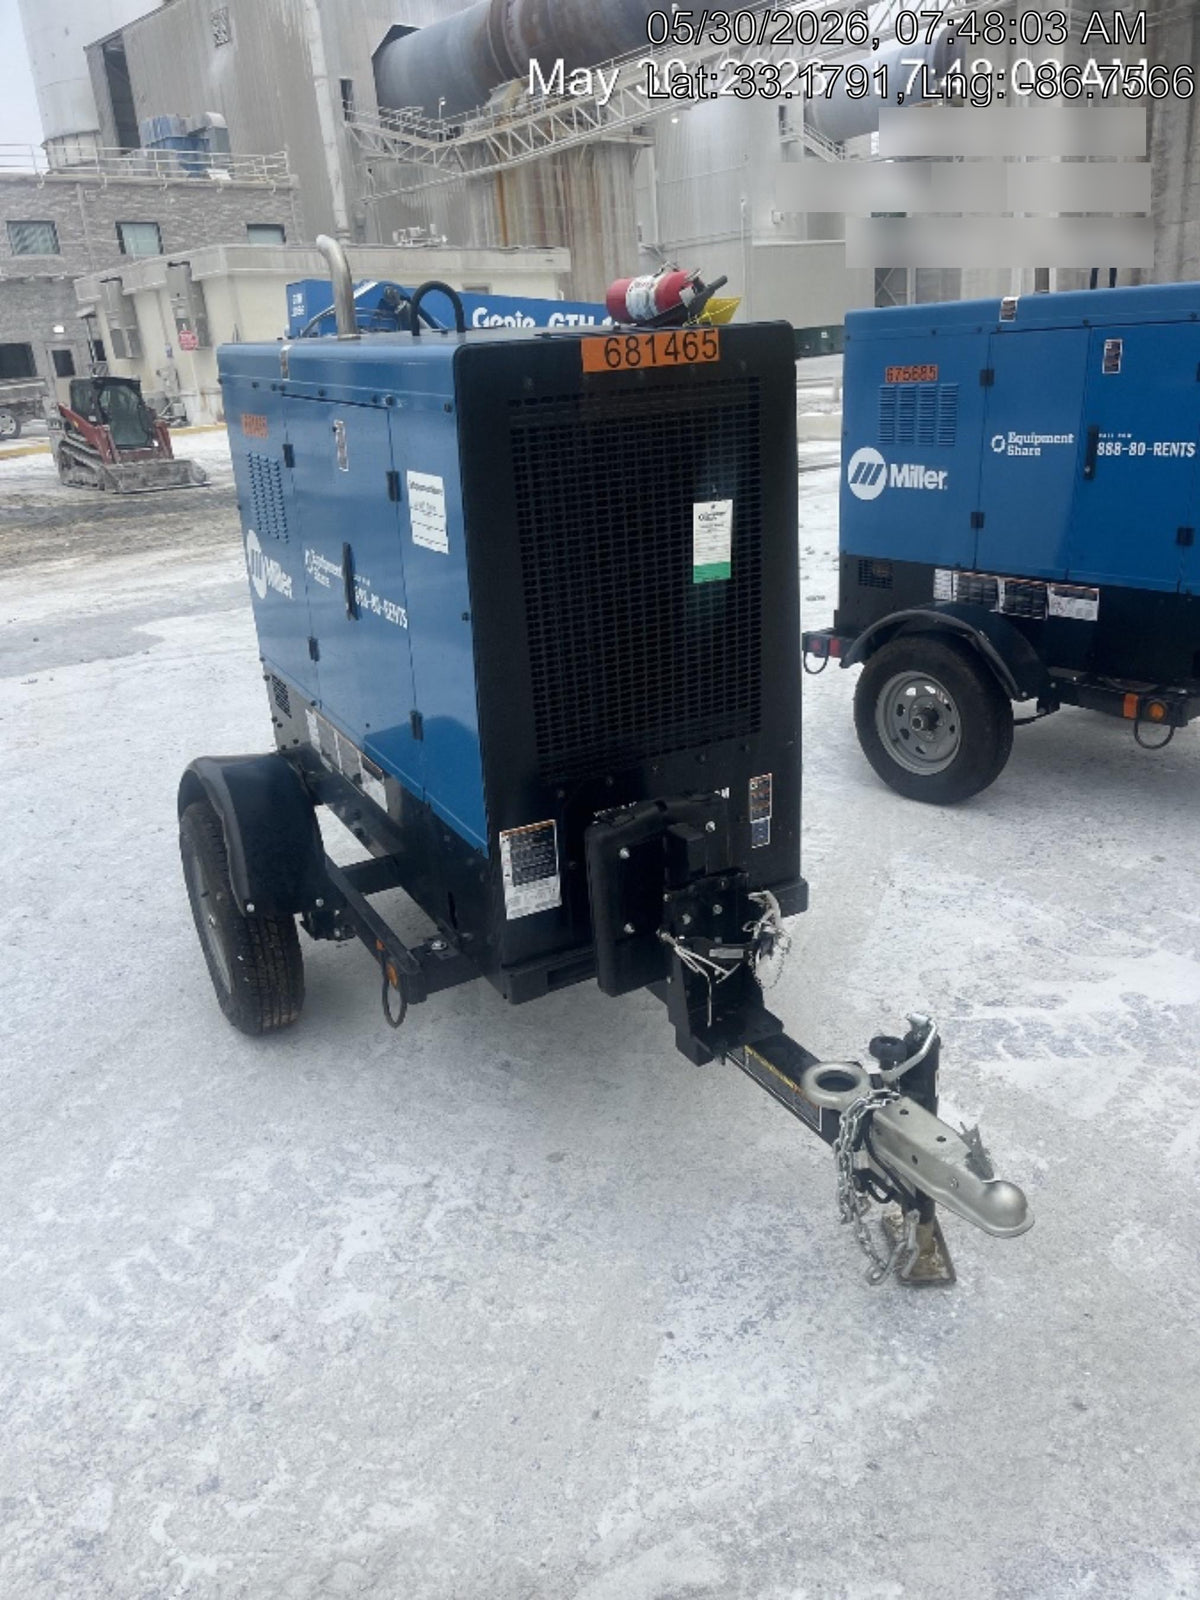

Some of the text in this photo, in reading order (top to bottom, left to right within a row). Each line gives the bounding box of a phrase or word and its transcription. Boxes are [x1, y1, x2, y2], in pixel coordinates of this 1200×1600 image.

[604, 329, 718, 369] 681465
[1007, 431, 1075, 445] Equipment
[1007, 445, 1042, 457] Share
[1096, 441, 1196, 458] 888-80-RENTS
